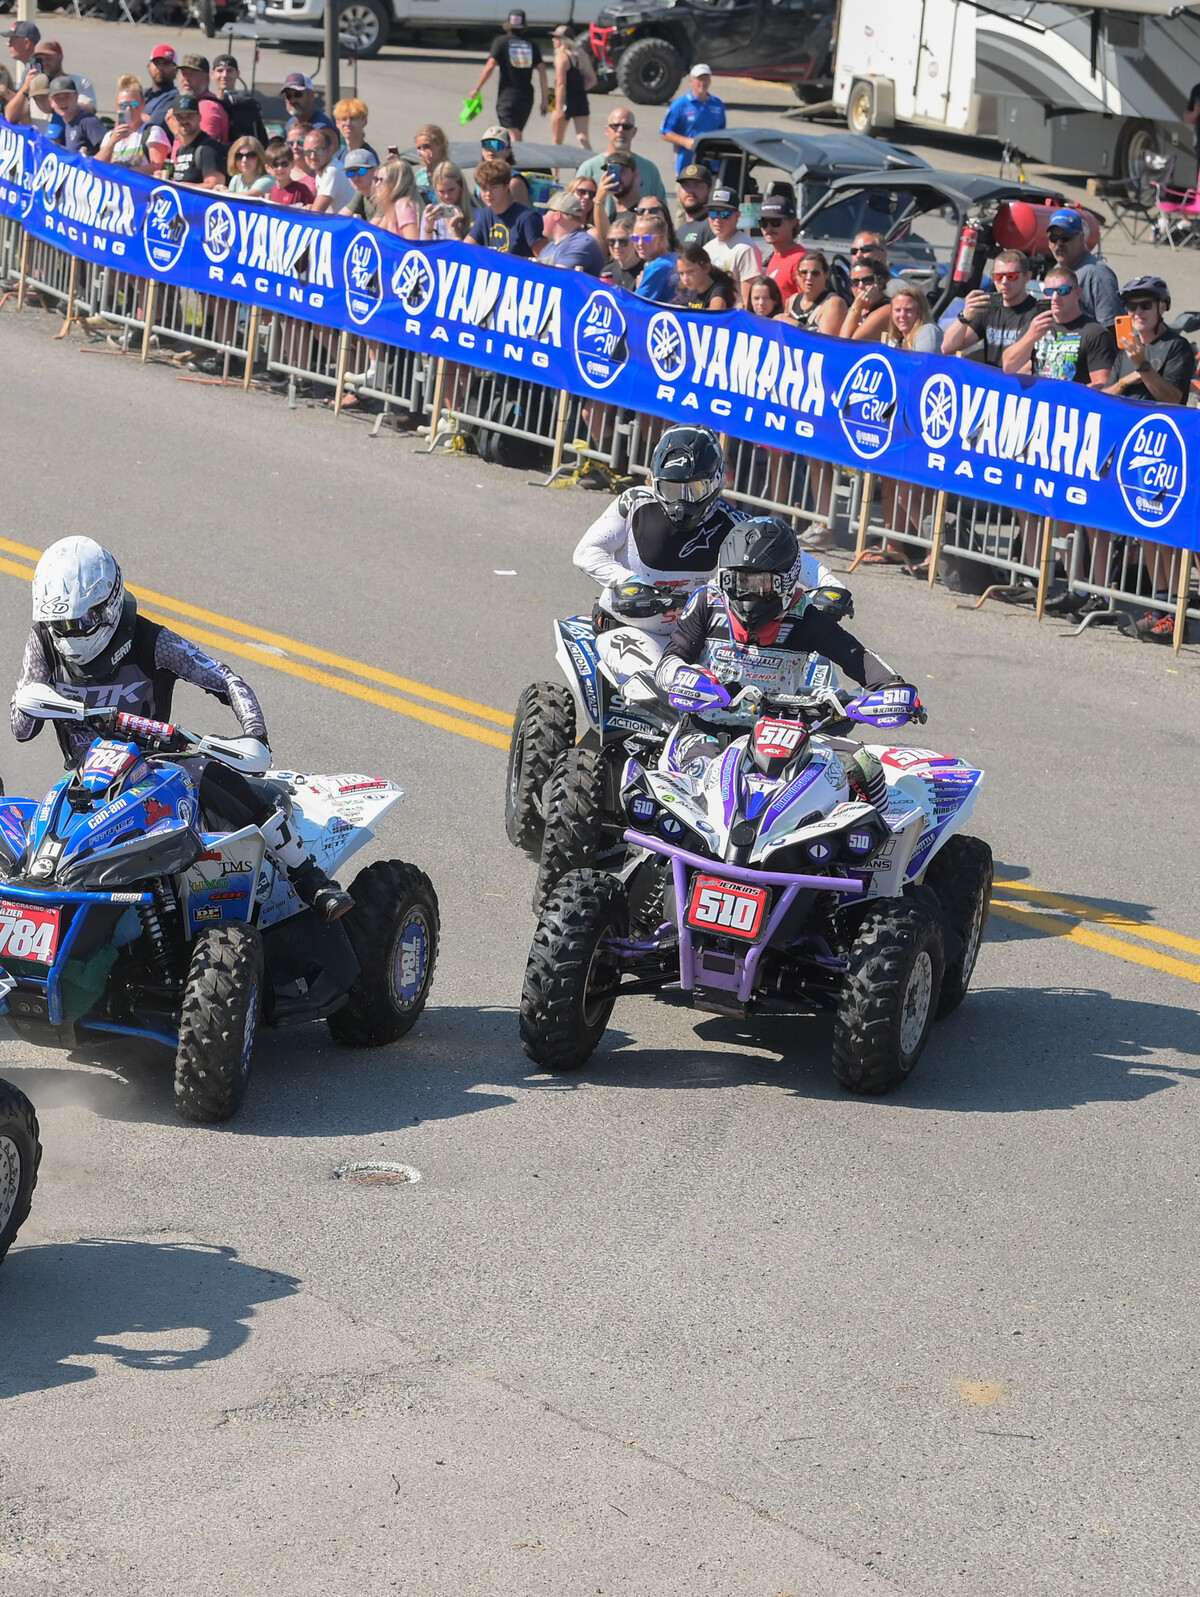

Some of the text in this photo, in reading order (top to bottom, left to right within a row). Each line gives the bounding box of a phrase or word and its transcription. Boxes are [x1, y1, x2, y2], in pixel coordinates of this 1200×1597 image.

[45, 214, 126, 256] RACING
[208, 265, 325, 309] RACING
[434, 258, 562, 348] YAMAHA
[404, 318, 550, 369] RACING
[687, 321, 825, 417] YAMAHA
[655, 384, 816, 439] RACING
[961, 383, 1102, 481] YAMAHA
[927, 452, 1088, 505] RACING
[566, 640, 592, 676] ACTION!
[715, 649, 782, 666] FULL THROTTLE
[675, 670, 700, 689] 510
[744, 672, 778, 681] KENDA
[673, 697, 694, 708] PGX
[882, 688, 911, 704] 510
[876, 714, 900, 725] PGX
[878, 706, 906, 714] JENKINS
[756, 725, 802, 750] 510
[84, 746, 131, 773] 784
[87, 798, 128, 830] can-am
[633, 799, 654, 815] 510
[48, 842, 56, 853] 1
[849, 834, 870, 846] 510
[219, 860, 253, 873] TMS
[192, 878, 229, 891] HVG
[719, 881, 761, 896] JENKINS
[197, 907, 220, 917] DP
[262, 899, 286, 914] can-am
[695, 888, 758, 932] 510
[400, 935, 417, 988] 784
